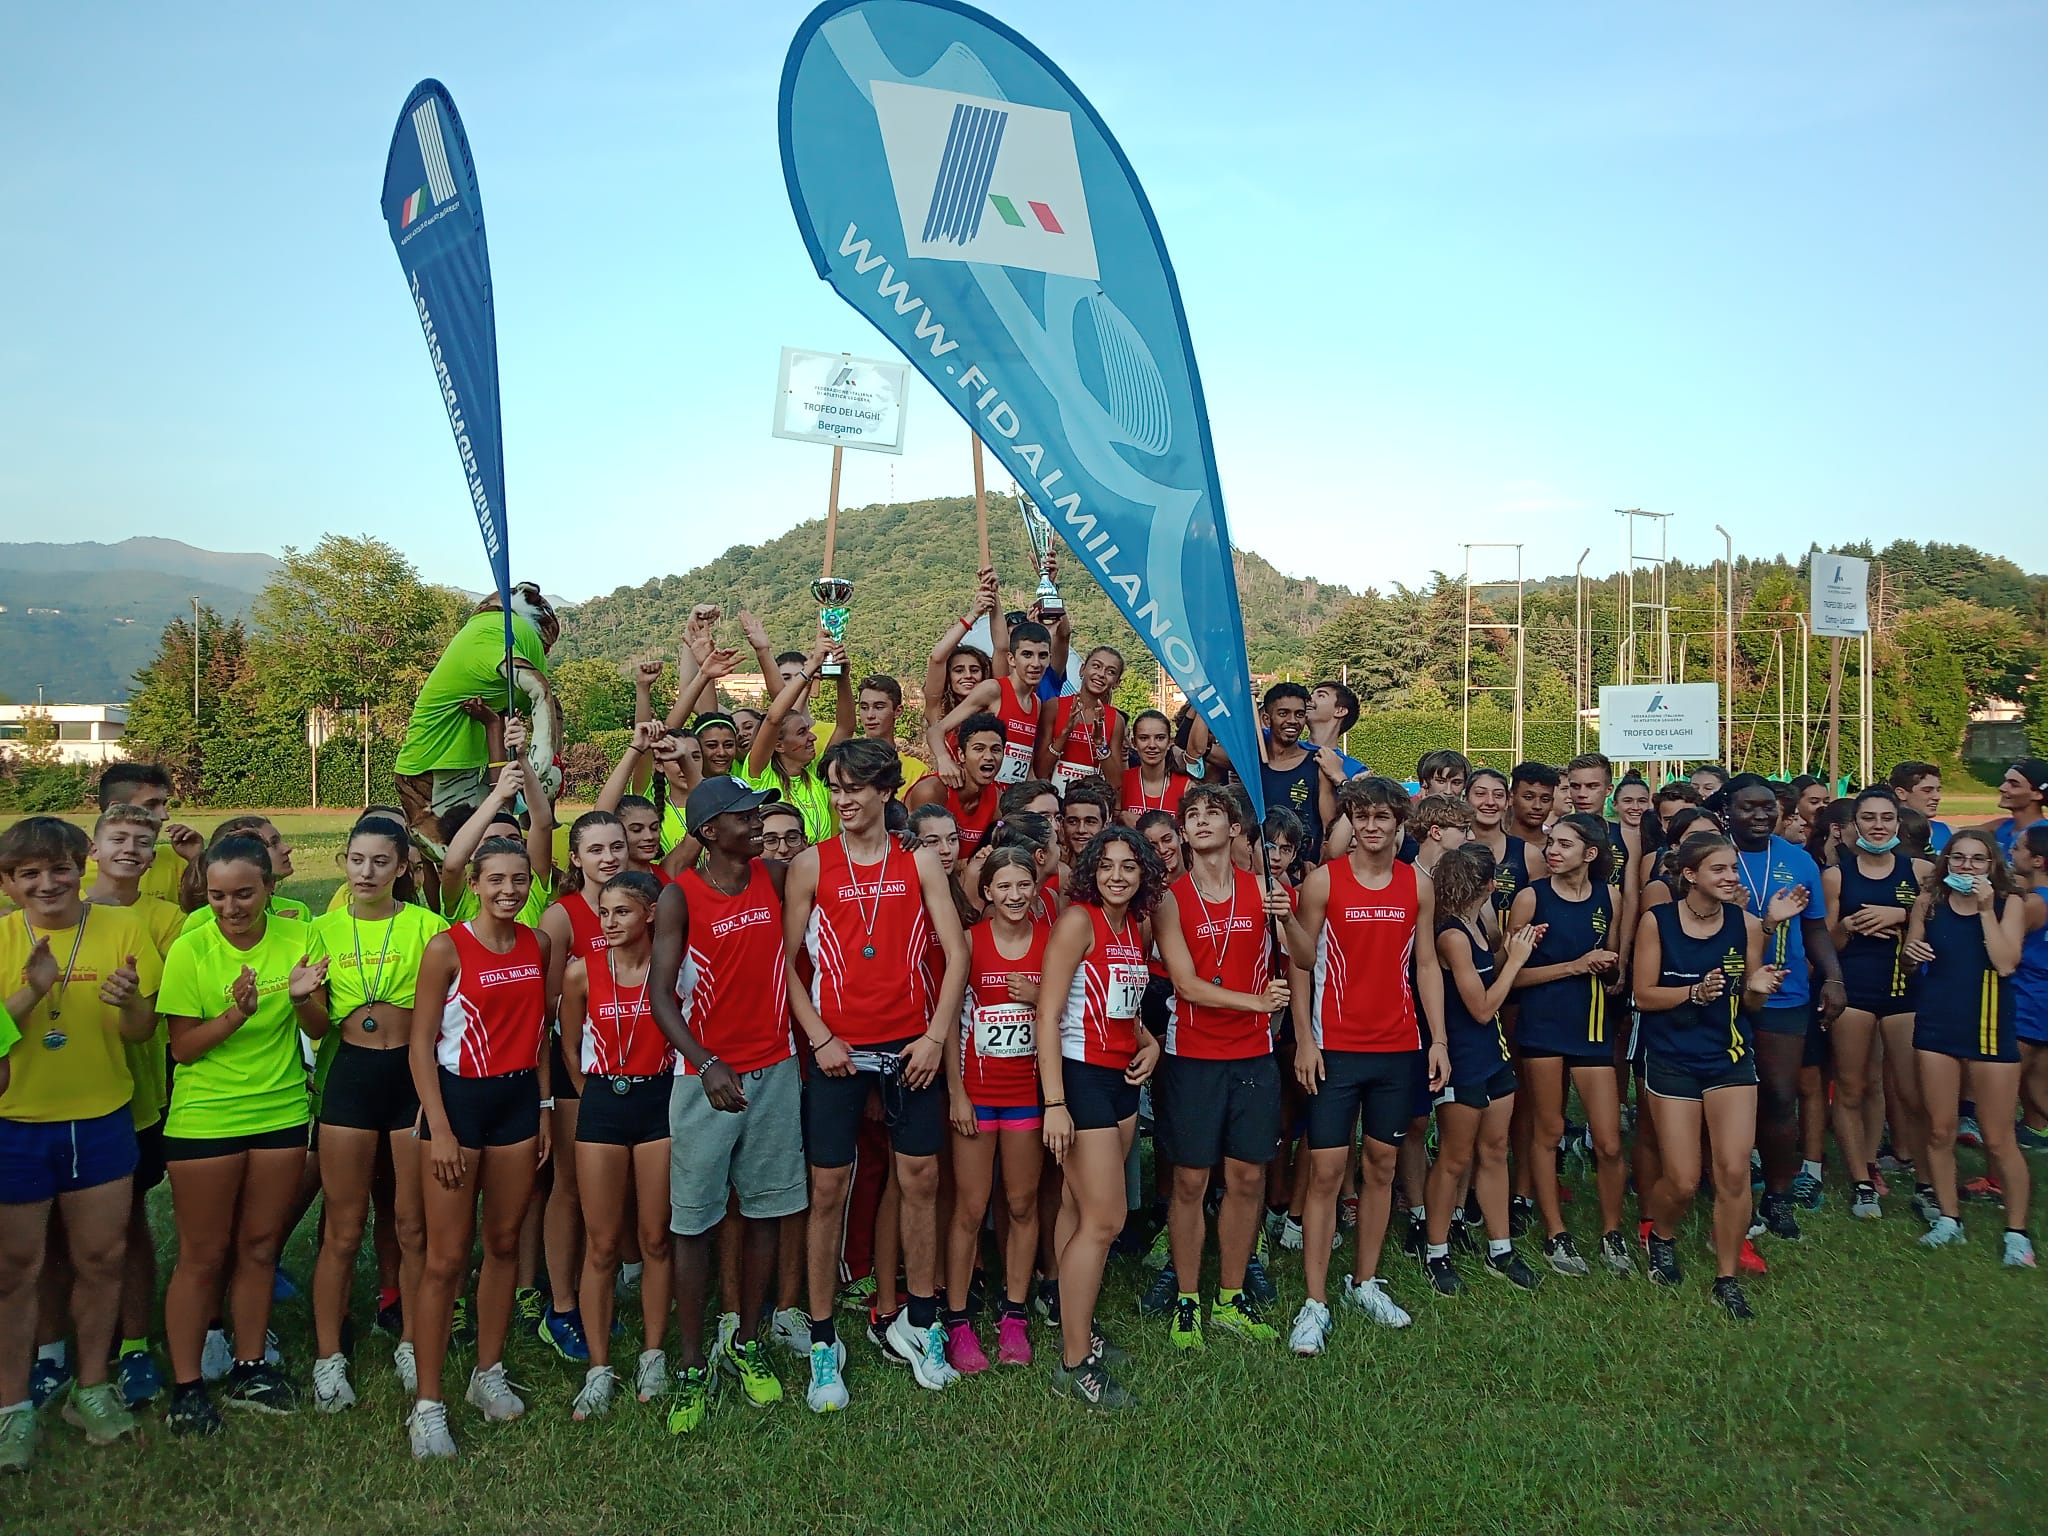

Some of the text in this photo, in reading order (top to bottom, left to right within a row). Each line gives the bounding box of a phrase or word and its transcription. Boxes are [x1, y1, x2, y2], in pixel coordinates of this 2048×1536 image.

[803, 402, 881, 421] TROFEO DEI LAGHI
[818, 420, 863, 435] Bergamo
[838, 221, 1232, 721] WWW.FIDALMILANO.IT
[1008, 721, 1024, 732] FIDAL
[1623, 728, 1693, 737] TROFEO DEI LAGHI
[1642, 742, 1673, 751] Varese
[1012, 760, 1028, 779] 22
[838, 886, 867, 899] FIDAL
[1345, 908, 1406, 919] FIDAL MILANO
[712, 919, 739, 936] FIDAL
[479, 966, 540, 985] FIDAL MILANO
[981, 975, 1006, 985] FIDAL
[599, 1005, 627, 1017] FIDAL
[987, 1023, 1032, 1047] 273
